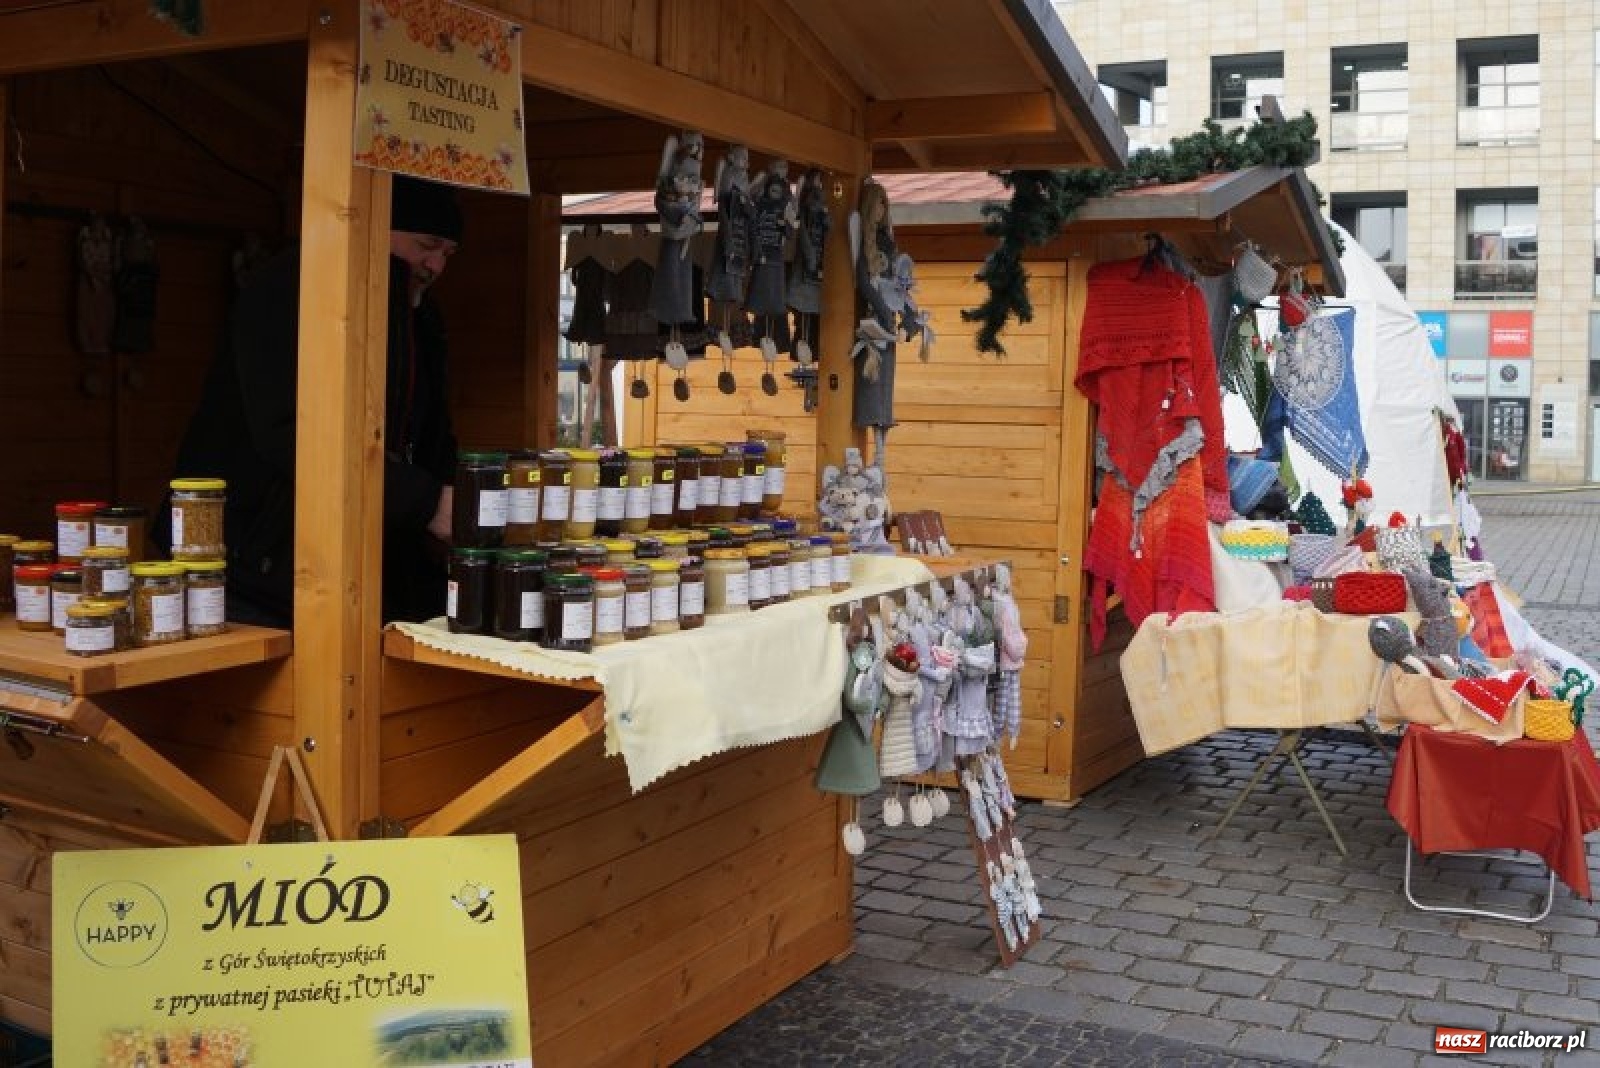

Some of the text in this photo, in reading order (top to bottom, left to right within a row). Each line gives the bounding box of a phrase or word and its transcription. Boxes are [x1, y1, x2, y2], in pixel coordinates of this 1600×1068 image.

[384, 59, 499, 111] DEGUSTACJA
[408, 101, 475, 133] TASTING
[201, 861, 390, 931] MIÓD
[87, 924, 156, 944] HAPPY
[202, 943, 388, 975] z Gór Świętokrzyskich
[153, 997, 165, 1011] z
[167, 985, 270, 1017] prywatnej
[271, 979, 342, 1011] pasieki
